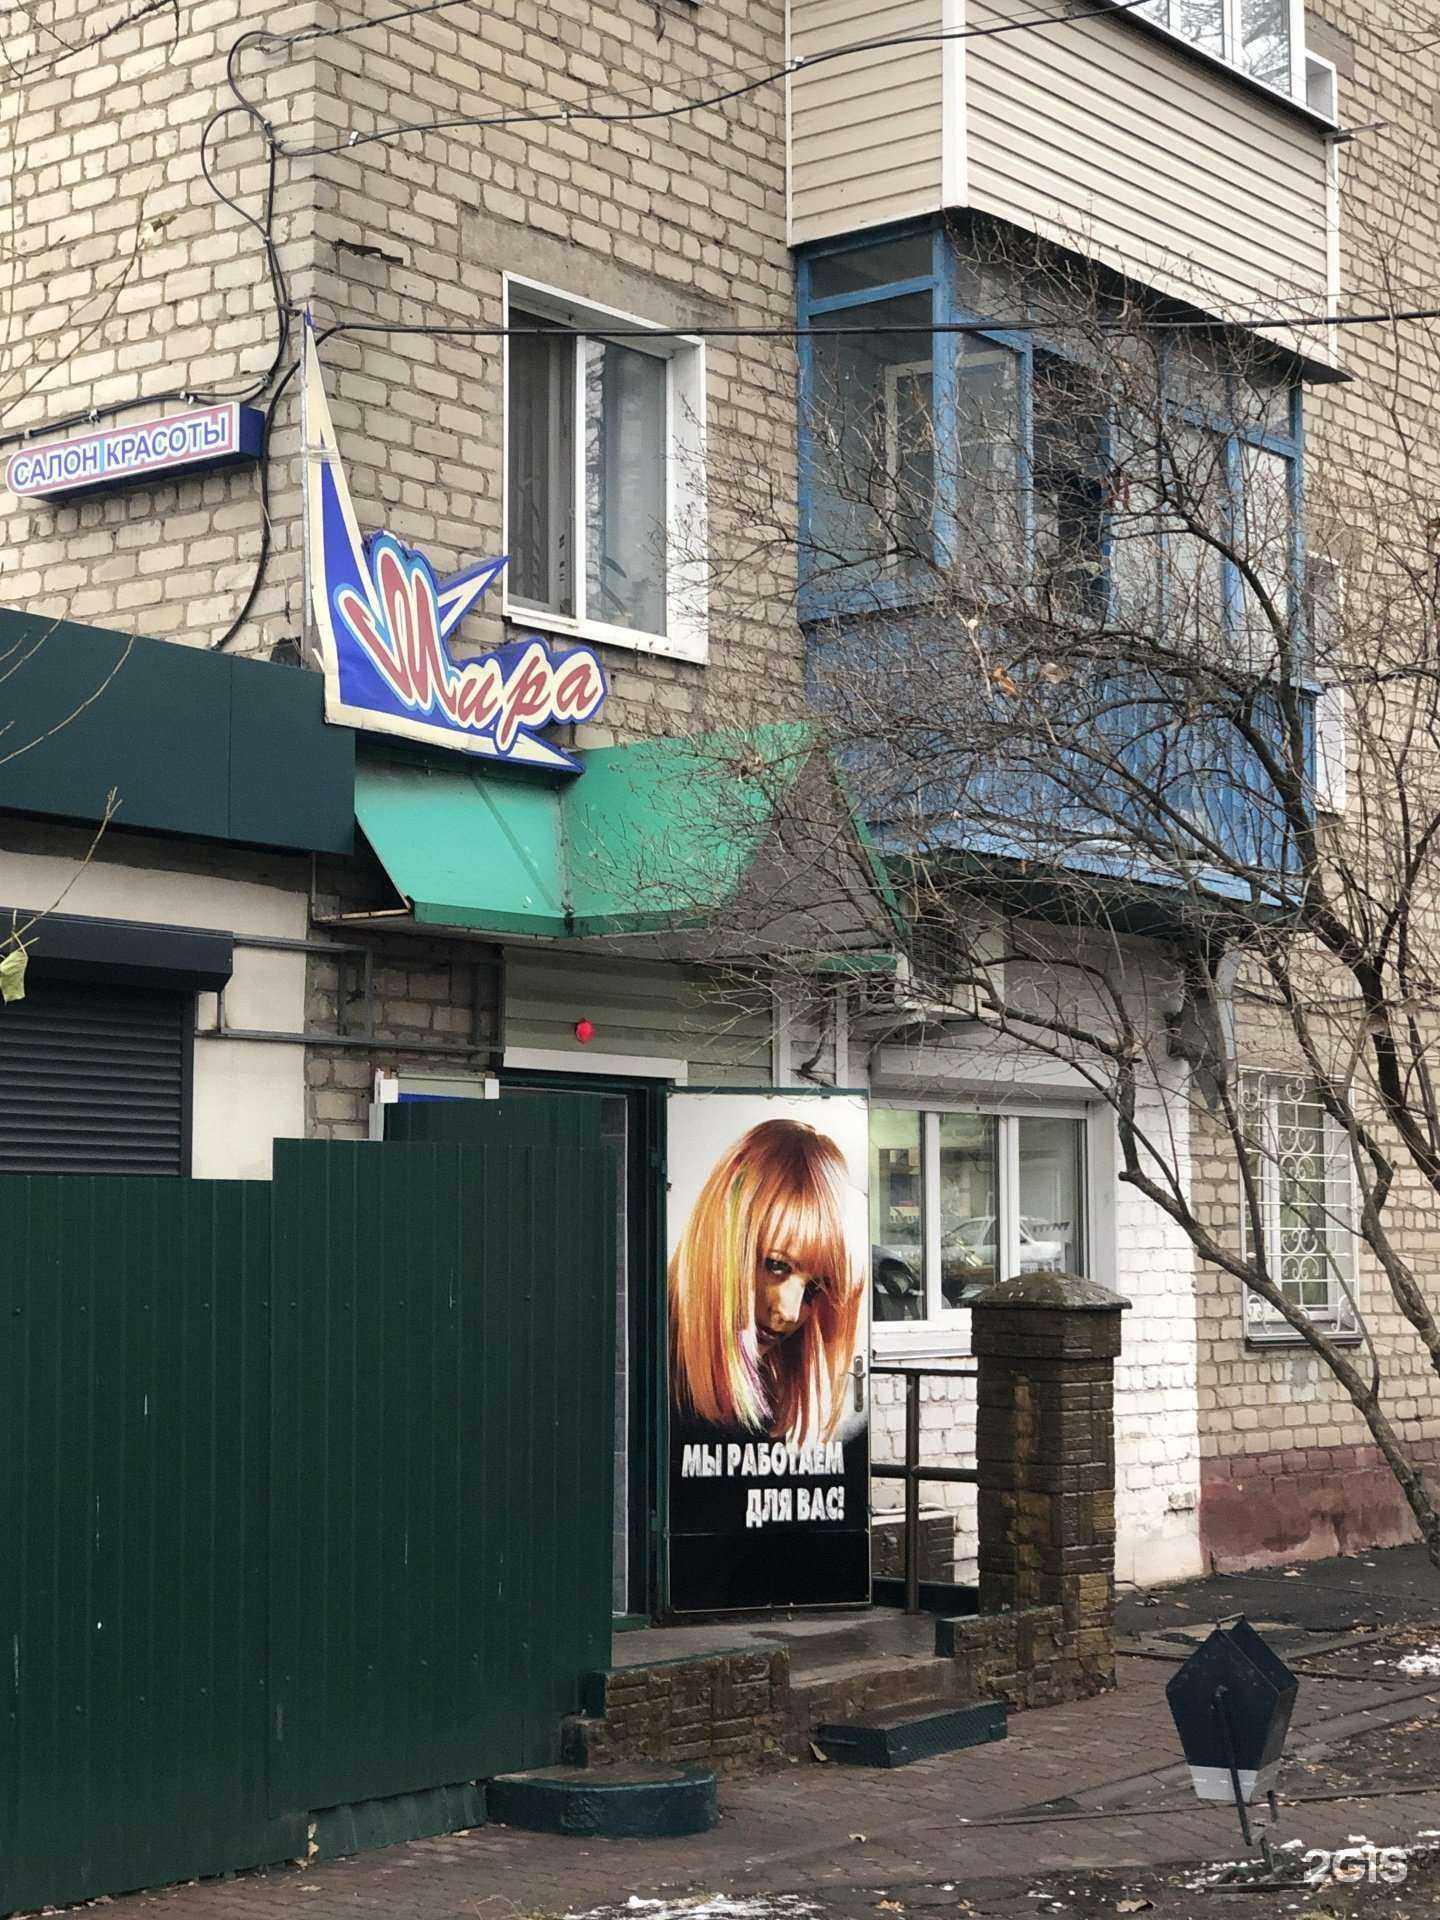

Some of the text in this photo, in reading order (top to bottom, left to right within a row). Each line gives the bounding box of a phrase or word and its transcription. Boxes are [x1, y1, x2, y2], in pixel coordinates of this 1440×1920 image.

[13, 417, 227, 486] САЛОН КРАСОТЫ
[339, 549, 601, 747] Мира
[681, 1441, 845, 1477] МЫ РАБОТАЕМ
[745, 1486, 845, 1528] ДЛЯ ВАС!
